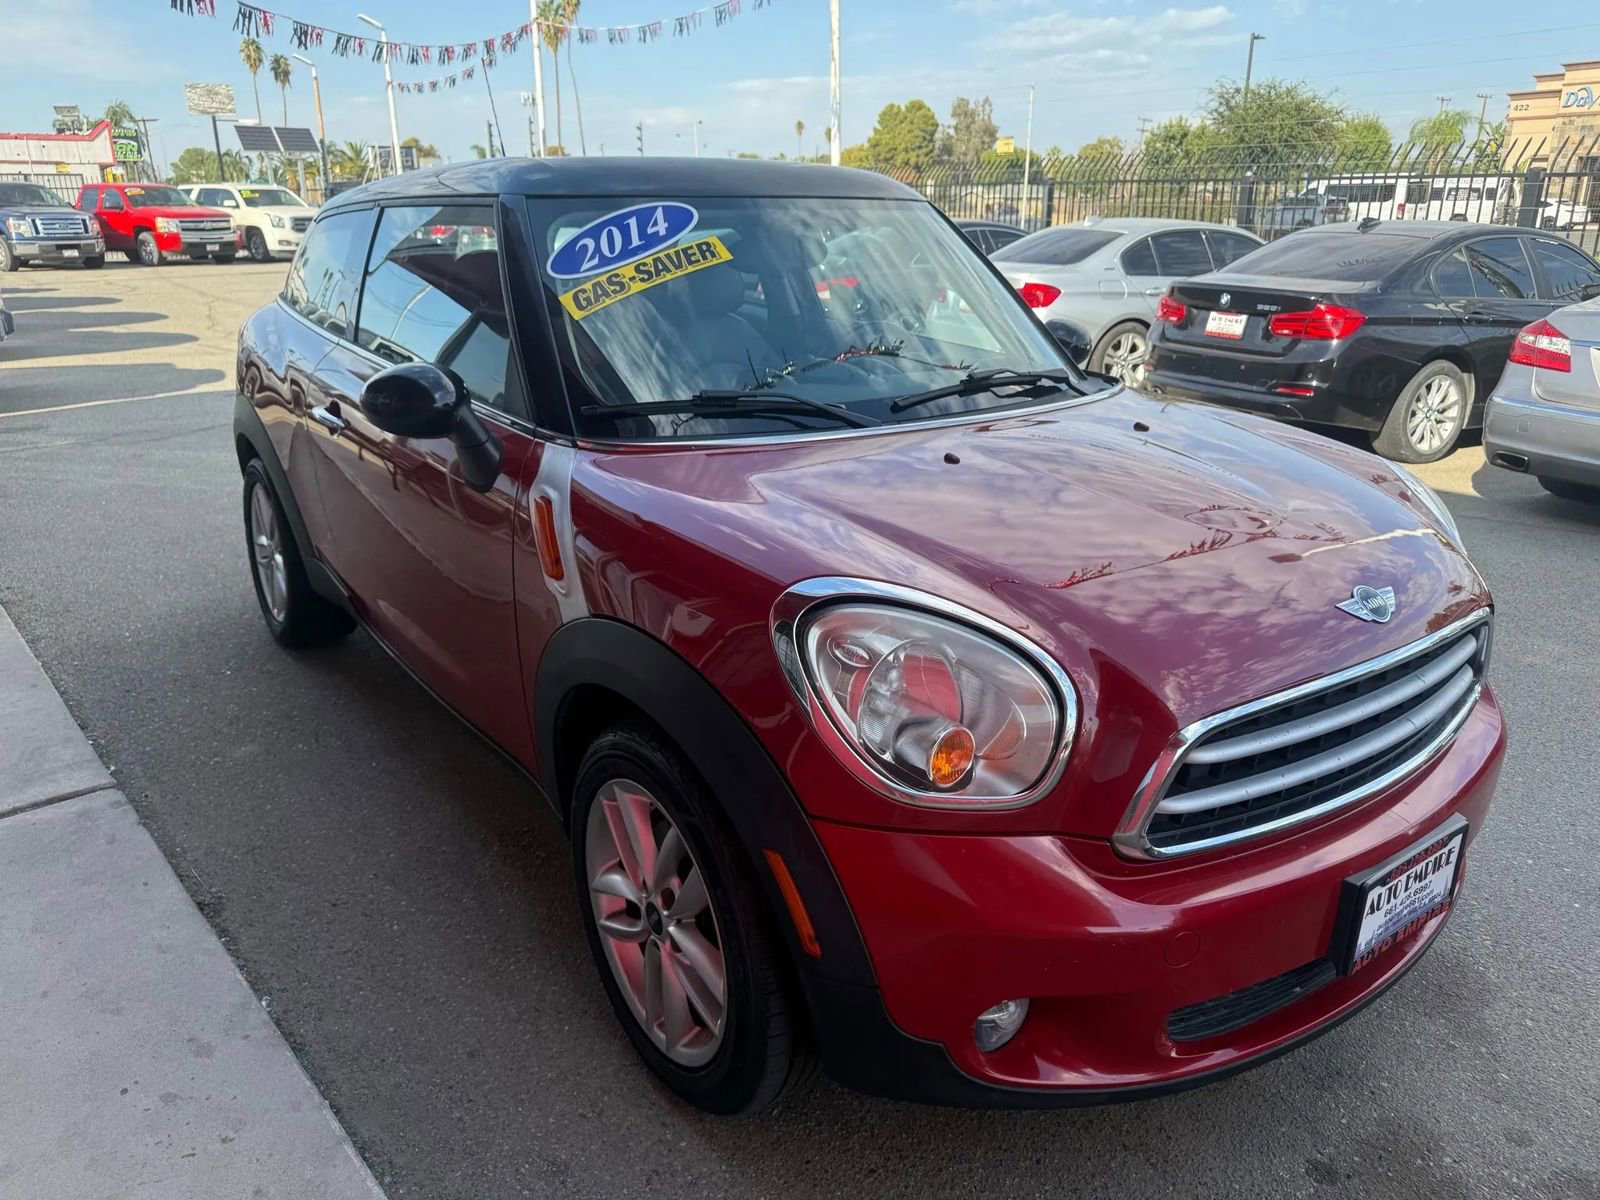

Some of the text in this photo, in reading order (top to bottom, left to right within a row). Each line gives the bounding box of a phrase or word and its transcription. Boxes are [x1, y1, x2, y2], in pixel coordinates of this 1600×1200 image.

[575, 206, 669, 272] 2014
[572, 240, 722, 313] GAS-SAVER
[1362, 595, 1385, 611] MINI
[1365, 879, 1403, 919] AUTO
[1404, 846, 1456, 893] EMPIRE
